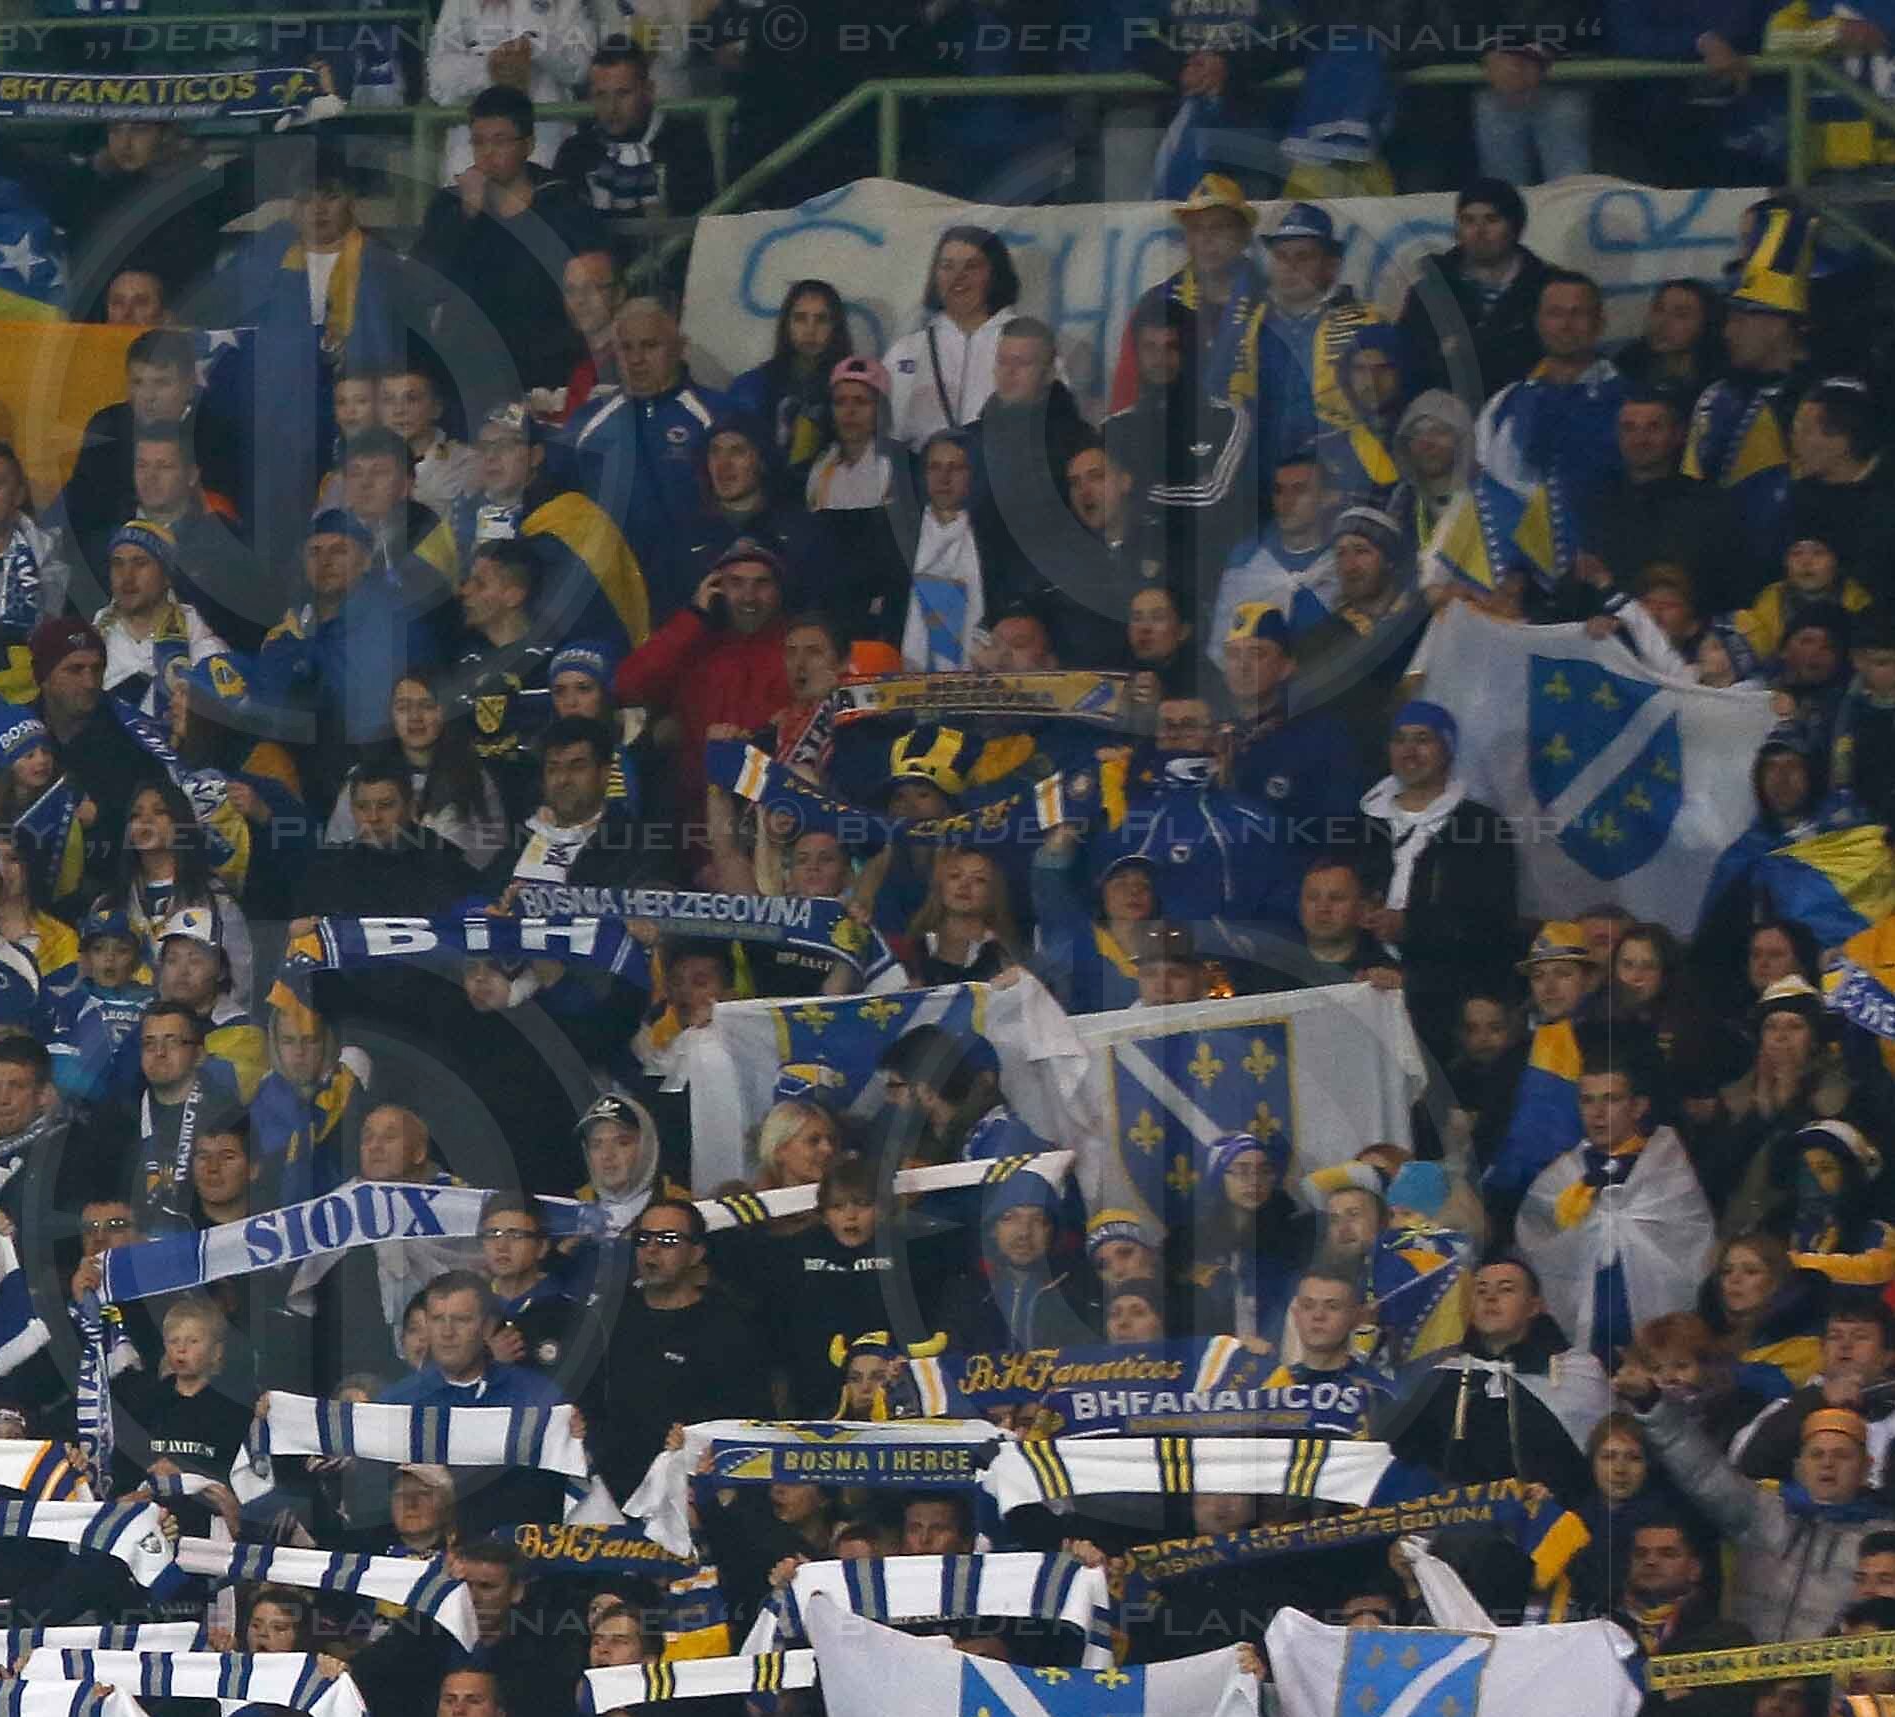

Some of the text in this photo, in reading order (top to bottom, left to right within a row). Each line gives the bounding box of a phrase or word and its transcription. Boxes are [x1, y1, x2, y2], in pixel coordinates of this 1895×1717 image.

[37, 72, 257, 100] FANATICOS
[621, 888, 813, 929] HERZEGOVINA
[243, 1183, 445, 1267] SIOUX
[958, 1346, 1183, 1393] BHFanaticos
[782, 1450, 869, 1472] BOSNA
